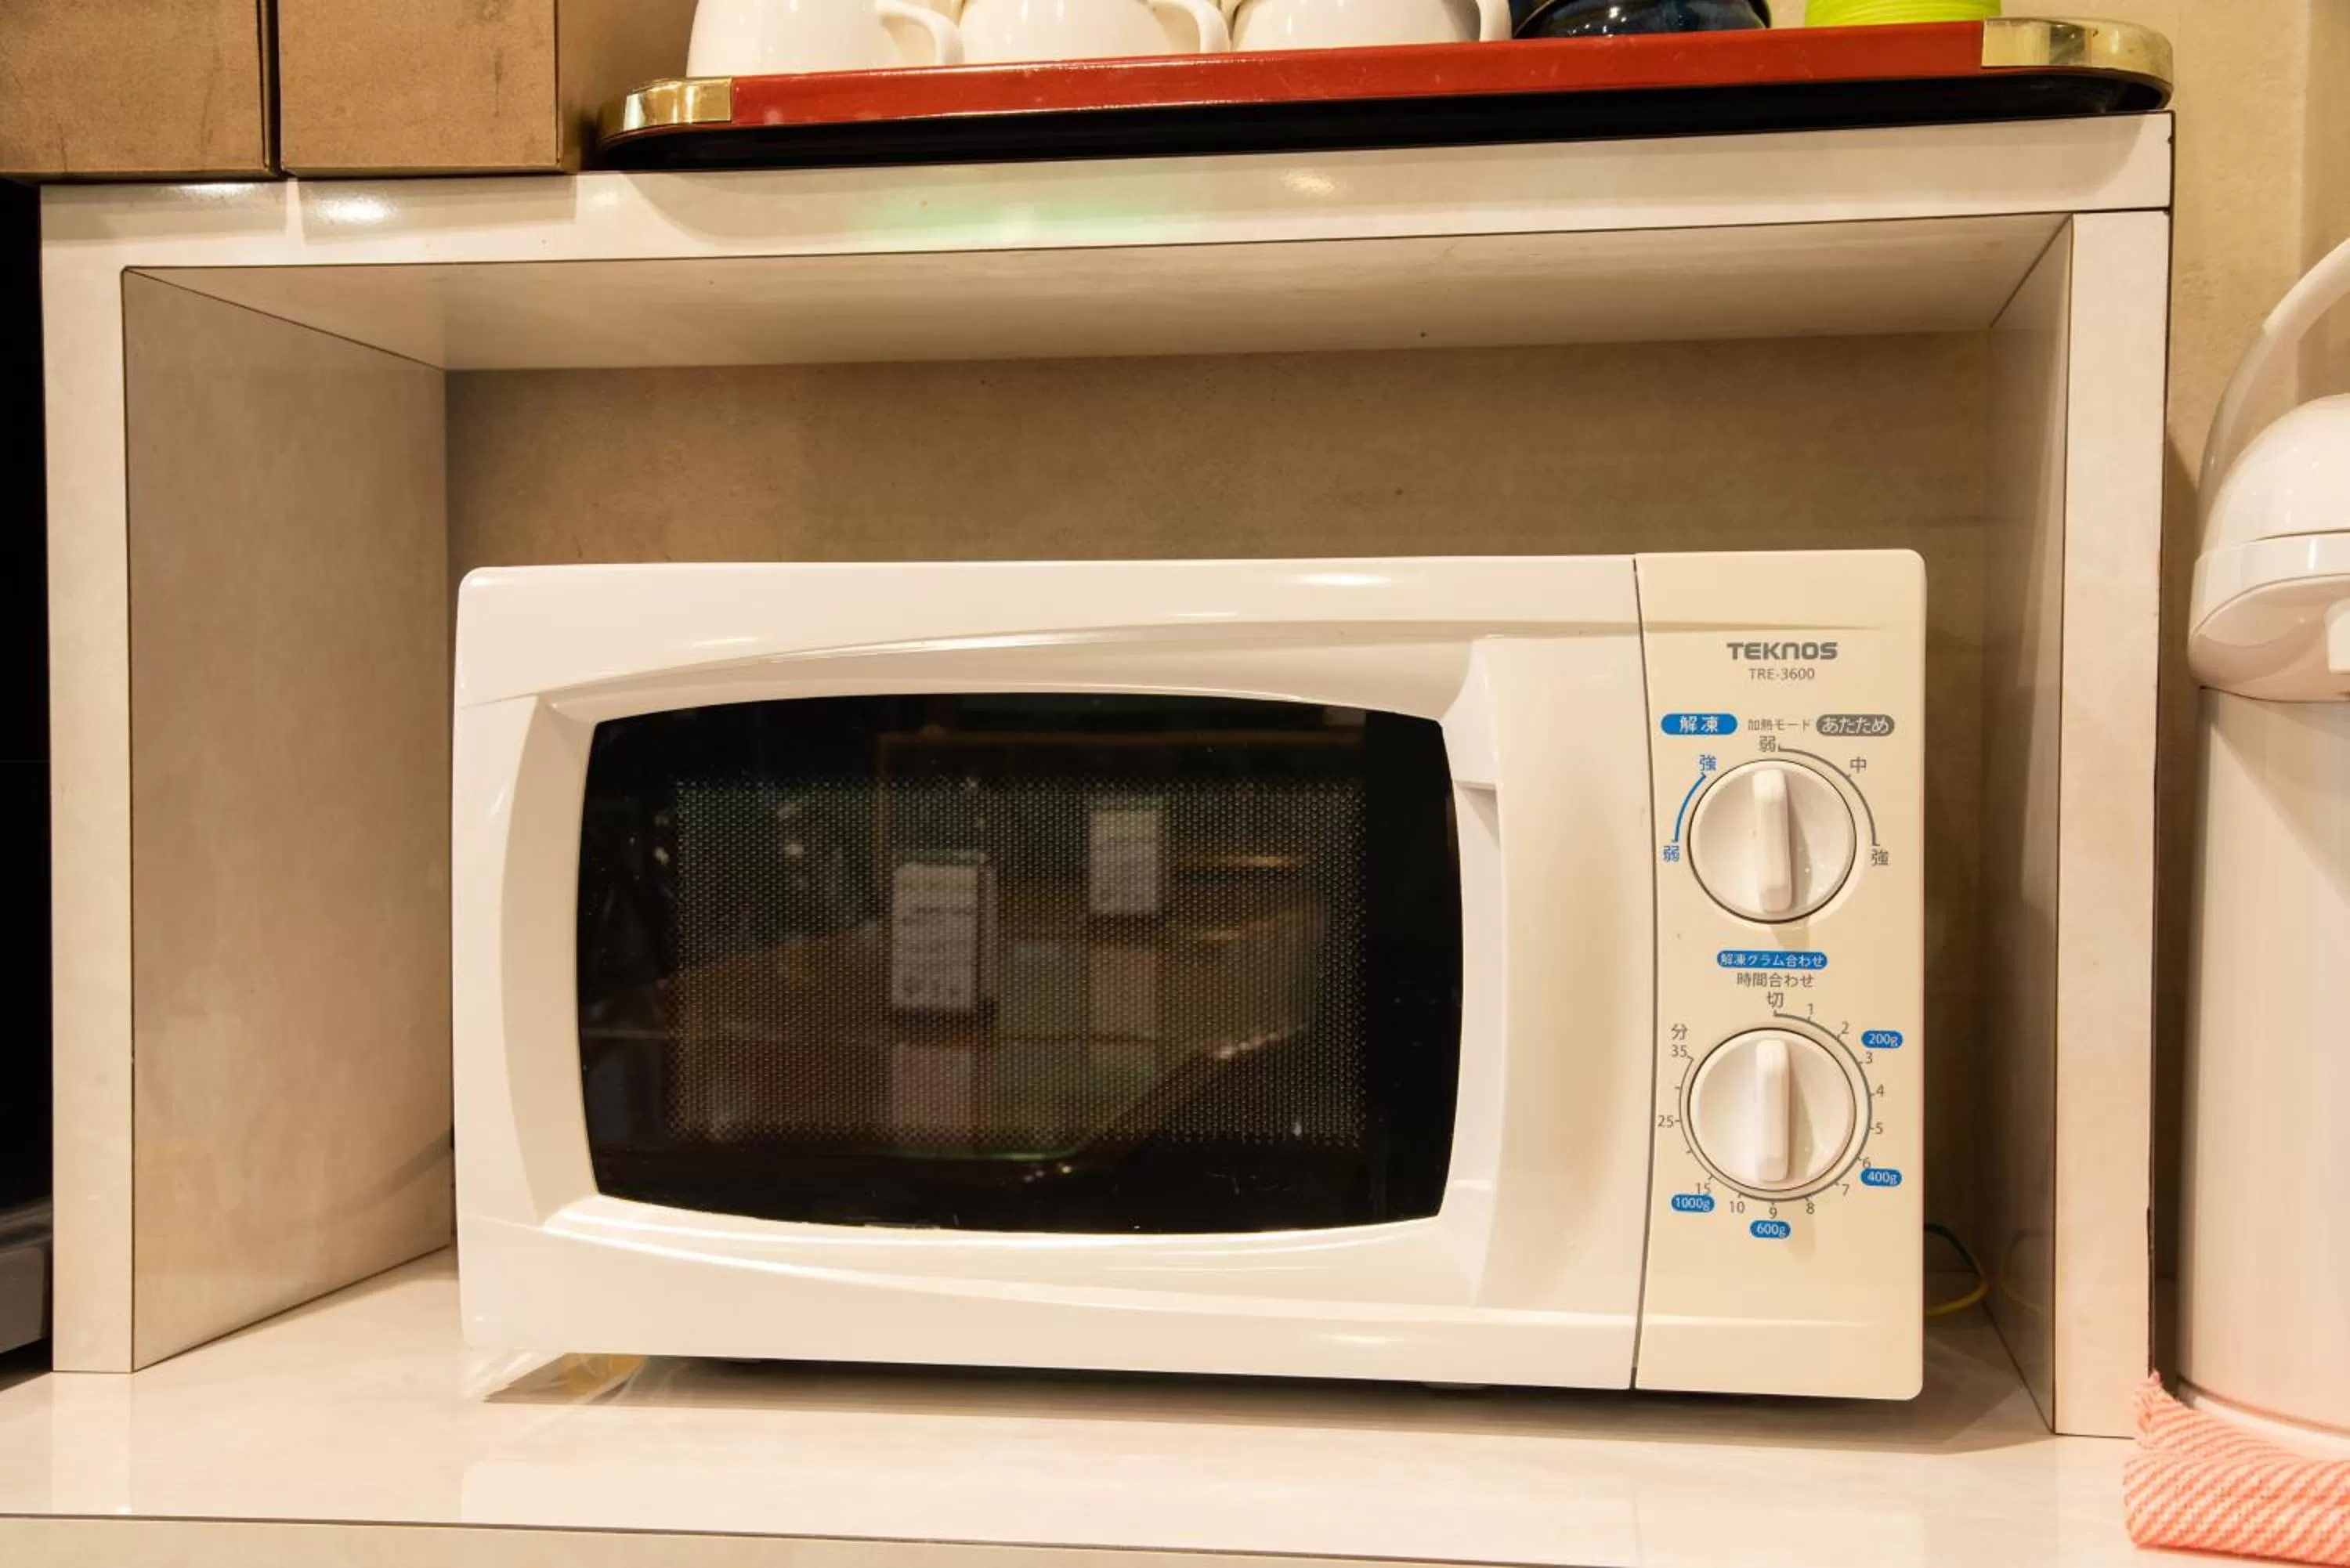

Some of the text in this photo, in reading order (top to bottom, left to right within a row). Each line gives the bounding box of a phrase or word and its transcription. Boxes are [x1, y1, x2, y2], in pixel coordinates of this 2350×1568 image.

[1748, 668, 1815, 681] TRE-3600
[1679, 715, 1719, 733] 解凍
[1748, 718, 1811, 732] 加熱モード
[1821, 716, 1889, 734] あたため
[1759, 735, 1777, 753] 弱
[1699, 754, 1717, 772] 強
[1850, 757, 1867, 774] 中
[1662, 846, 1680, 863] 弱
[1871, 848, 1889, 866] 強
[1720, 952, 1824, 968] 解凍グラム合わせ
[1737, 973, 1813, 988] 時間合わせ
[1766, 992, 1784, 1009] 切
[1807, 1003, 1814, 1016] 1
[1671, 1024, 1688, 1040] 分
[1841, 1021, 1849, 1035] 2
[1868, 1032, 1898, 1048] 200g
[1671, 1044, 1687, 1058] 35
[1865, 1051, 1873, 1064] 3
[1876, 1084, 1885, 1096] 4
[1658, 1116, 1674, 1128] 25
[1875, 1122, 1883, 1134] 5
[1862, 1158, 1871, 1169] 6
[1867, 1170, 1897, 1186] 400g
[1697, 1183, 1712, 1194] 15
[1842, 1184, 1849, 1197] 7
[1675, 1195, 1711, 1210] 1000g
[1730, 1201, 1745, 1214] 10
[1806, 1201, 1815, 1215] 8
[1770, 1206, 1777, 1219] 9
[1756, 1223, 1786, 1237] 600g
